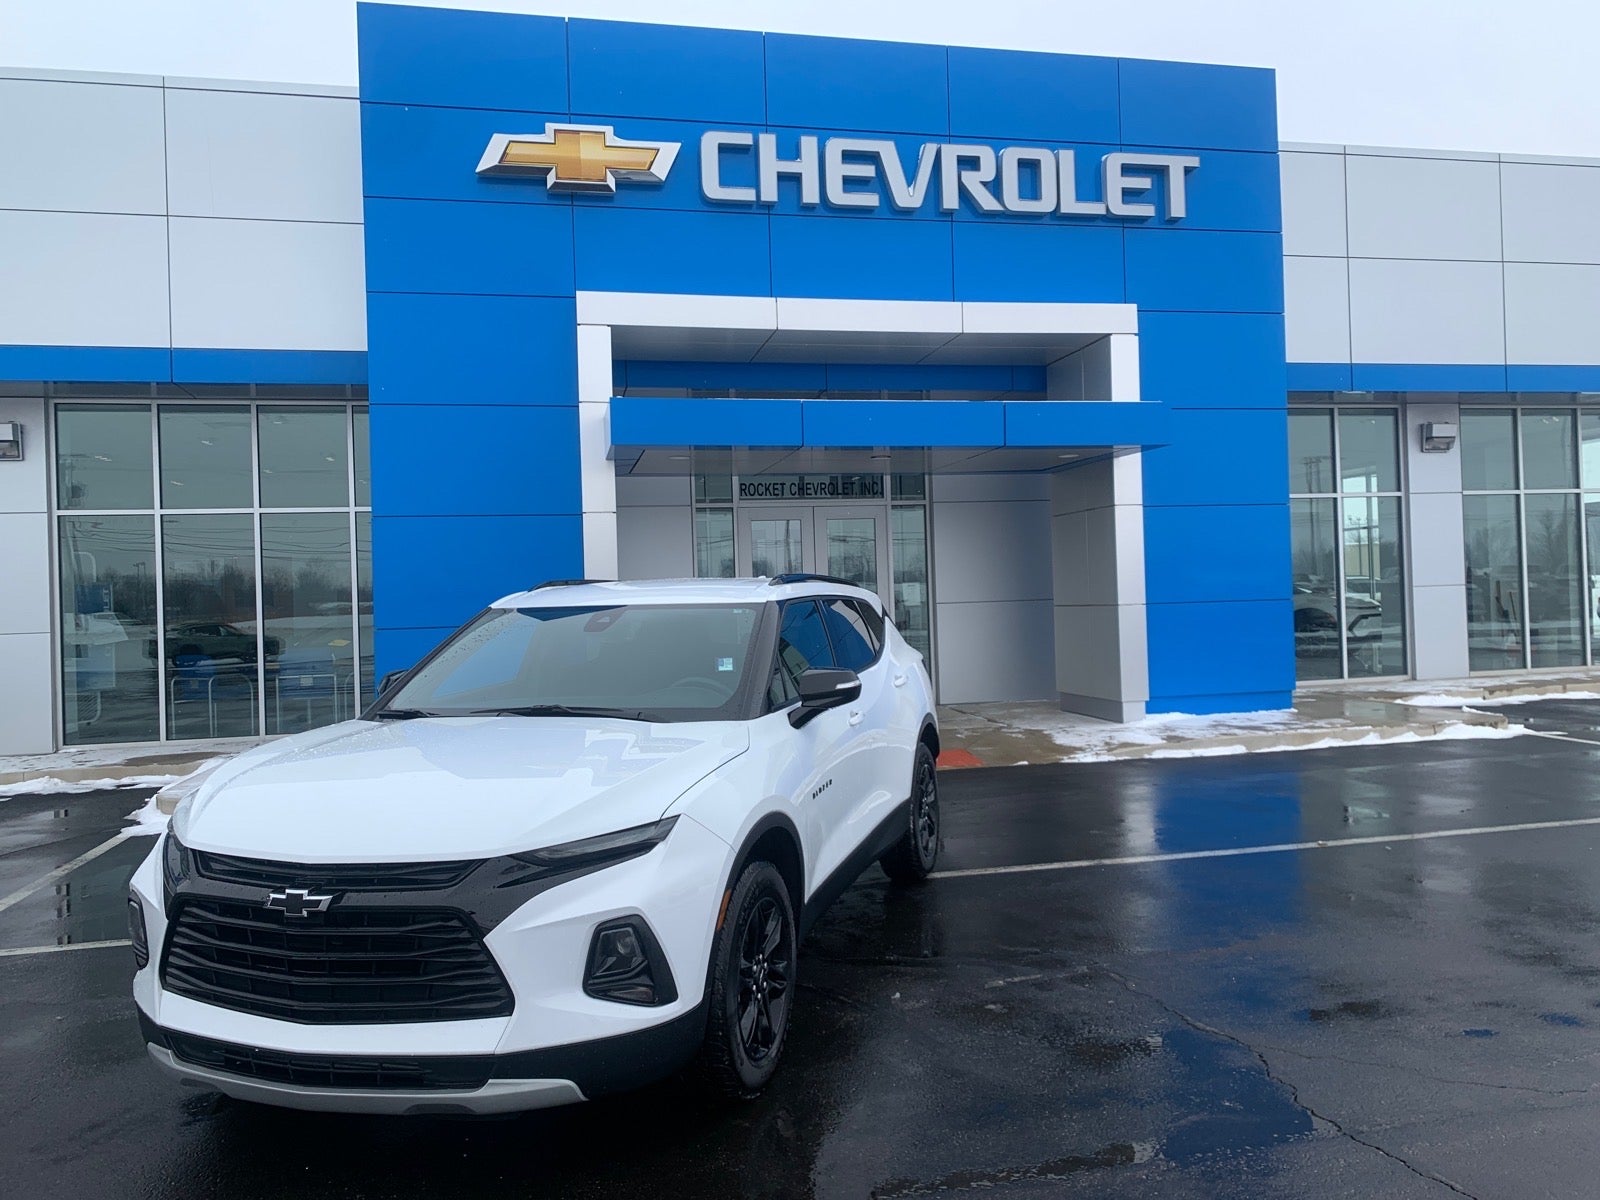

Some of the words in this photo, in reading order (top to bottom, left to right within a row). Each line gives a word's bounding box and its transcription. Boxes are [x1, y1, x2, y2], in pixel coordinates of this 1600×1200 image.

[699, 131, 1200, 220] CHEVROLET
[740, 482, 786, 497] ROCKET
[860, 482, 883, 496] INC.
